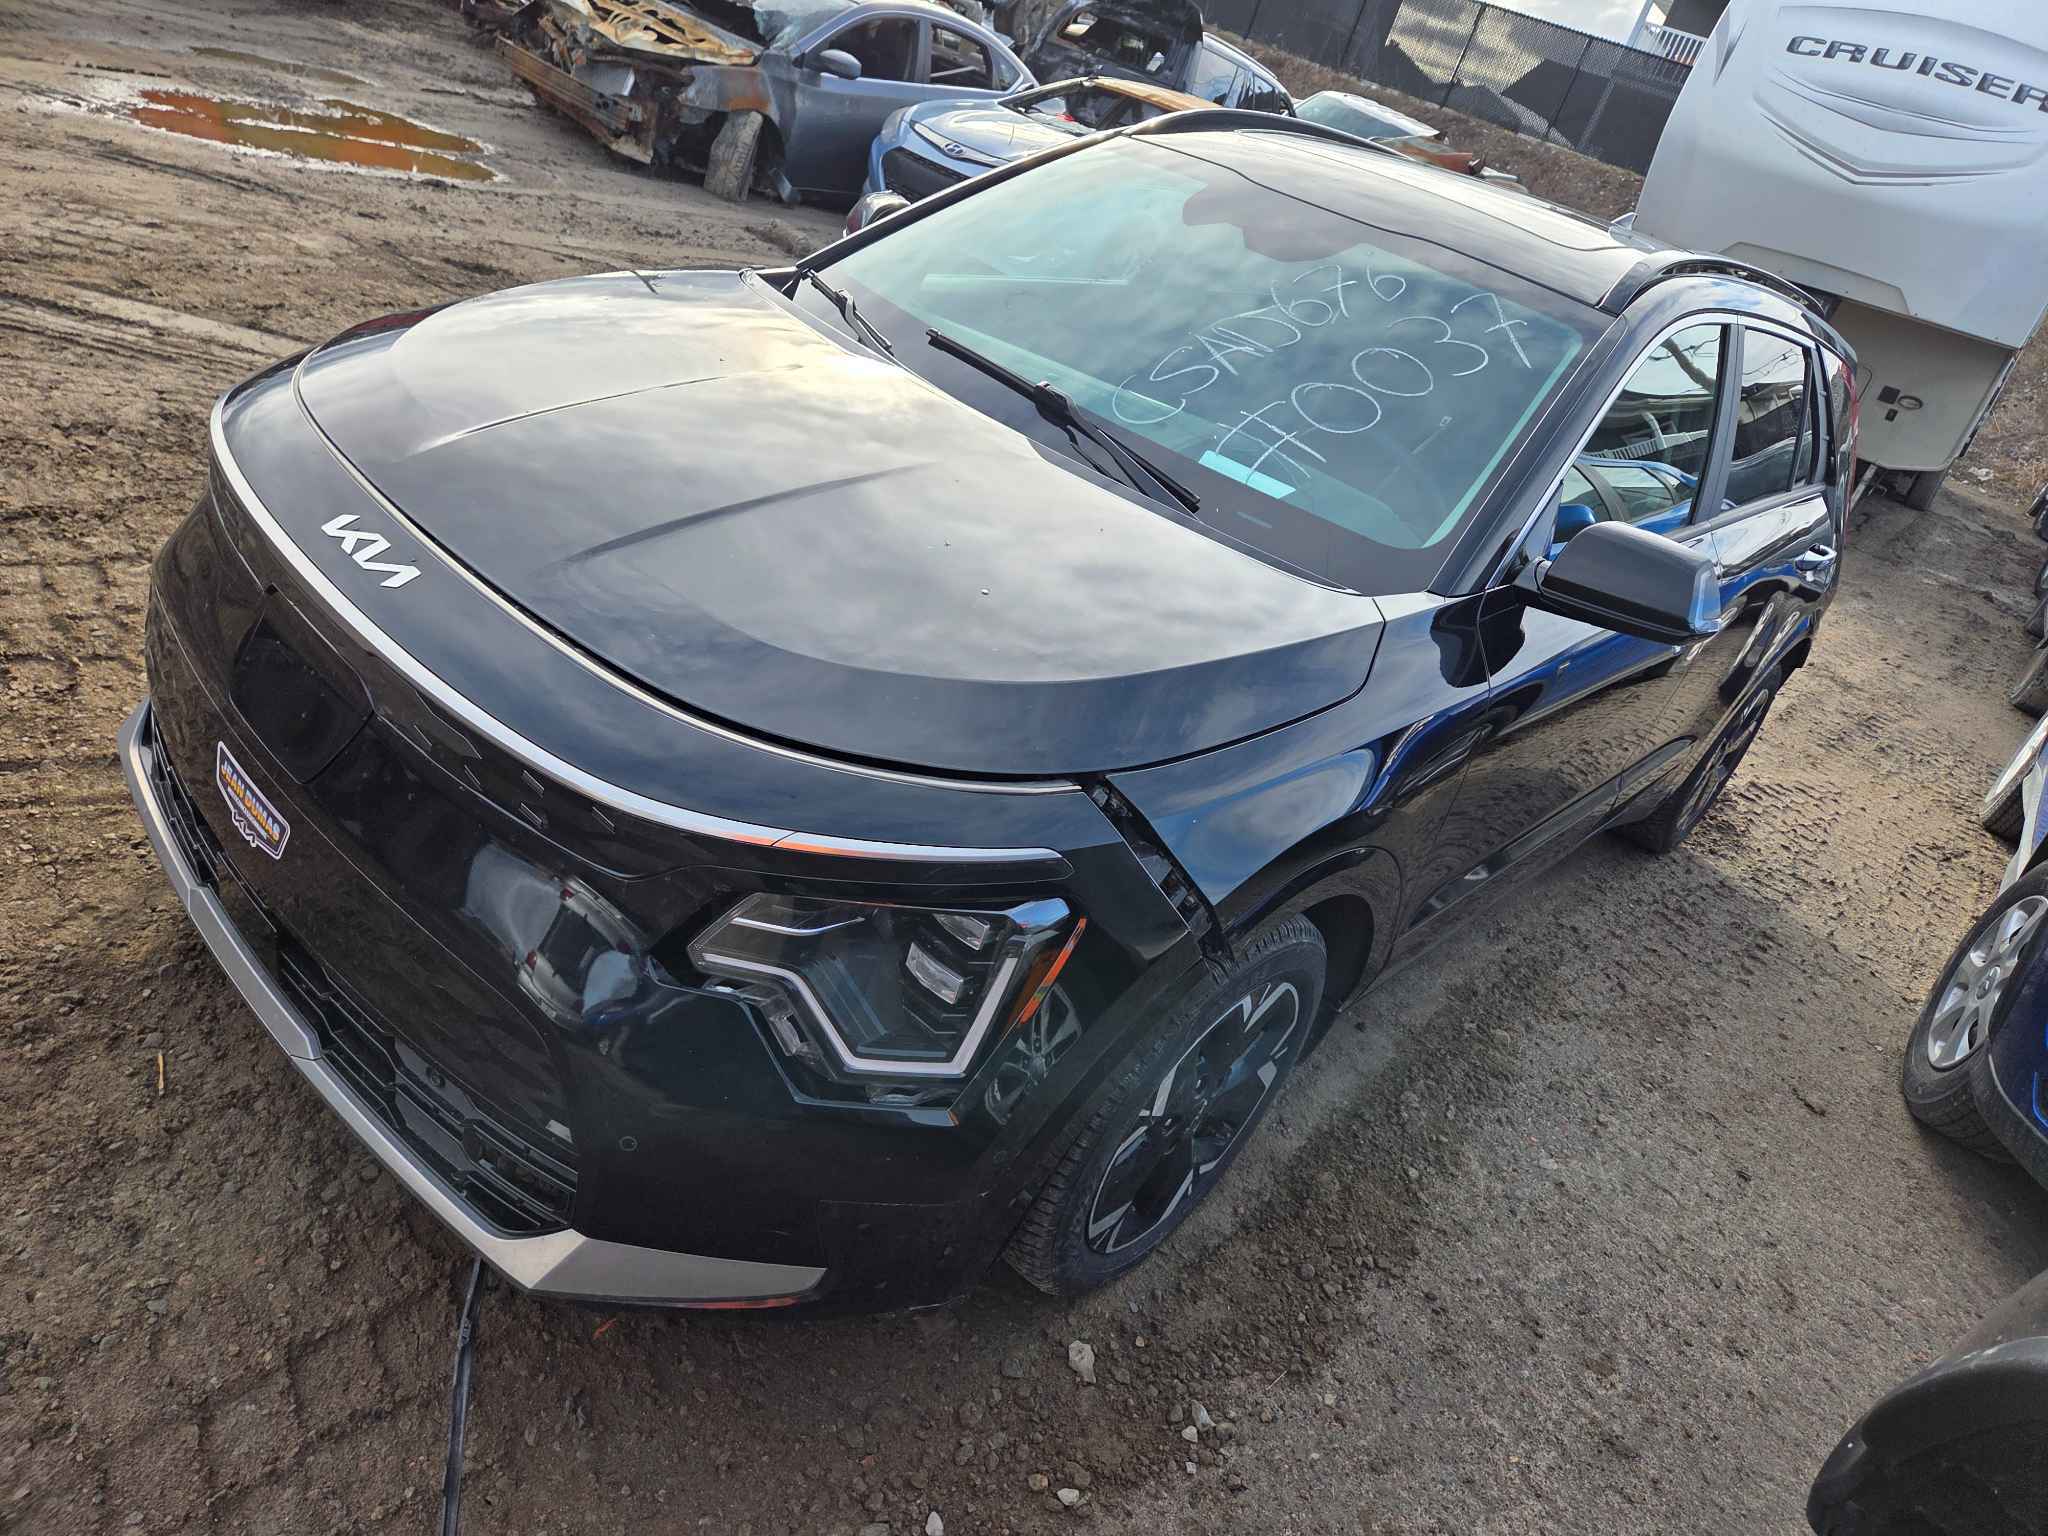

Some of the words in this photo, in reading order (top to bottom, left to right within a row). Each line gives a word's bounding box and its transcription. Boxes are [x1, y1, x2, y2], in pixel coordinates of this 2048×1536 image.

[1786, 36, 2048, 113] CRUISER
[1216, 293, 1532, 483] #0037
[321, 513, 422, 589] KIA
